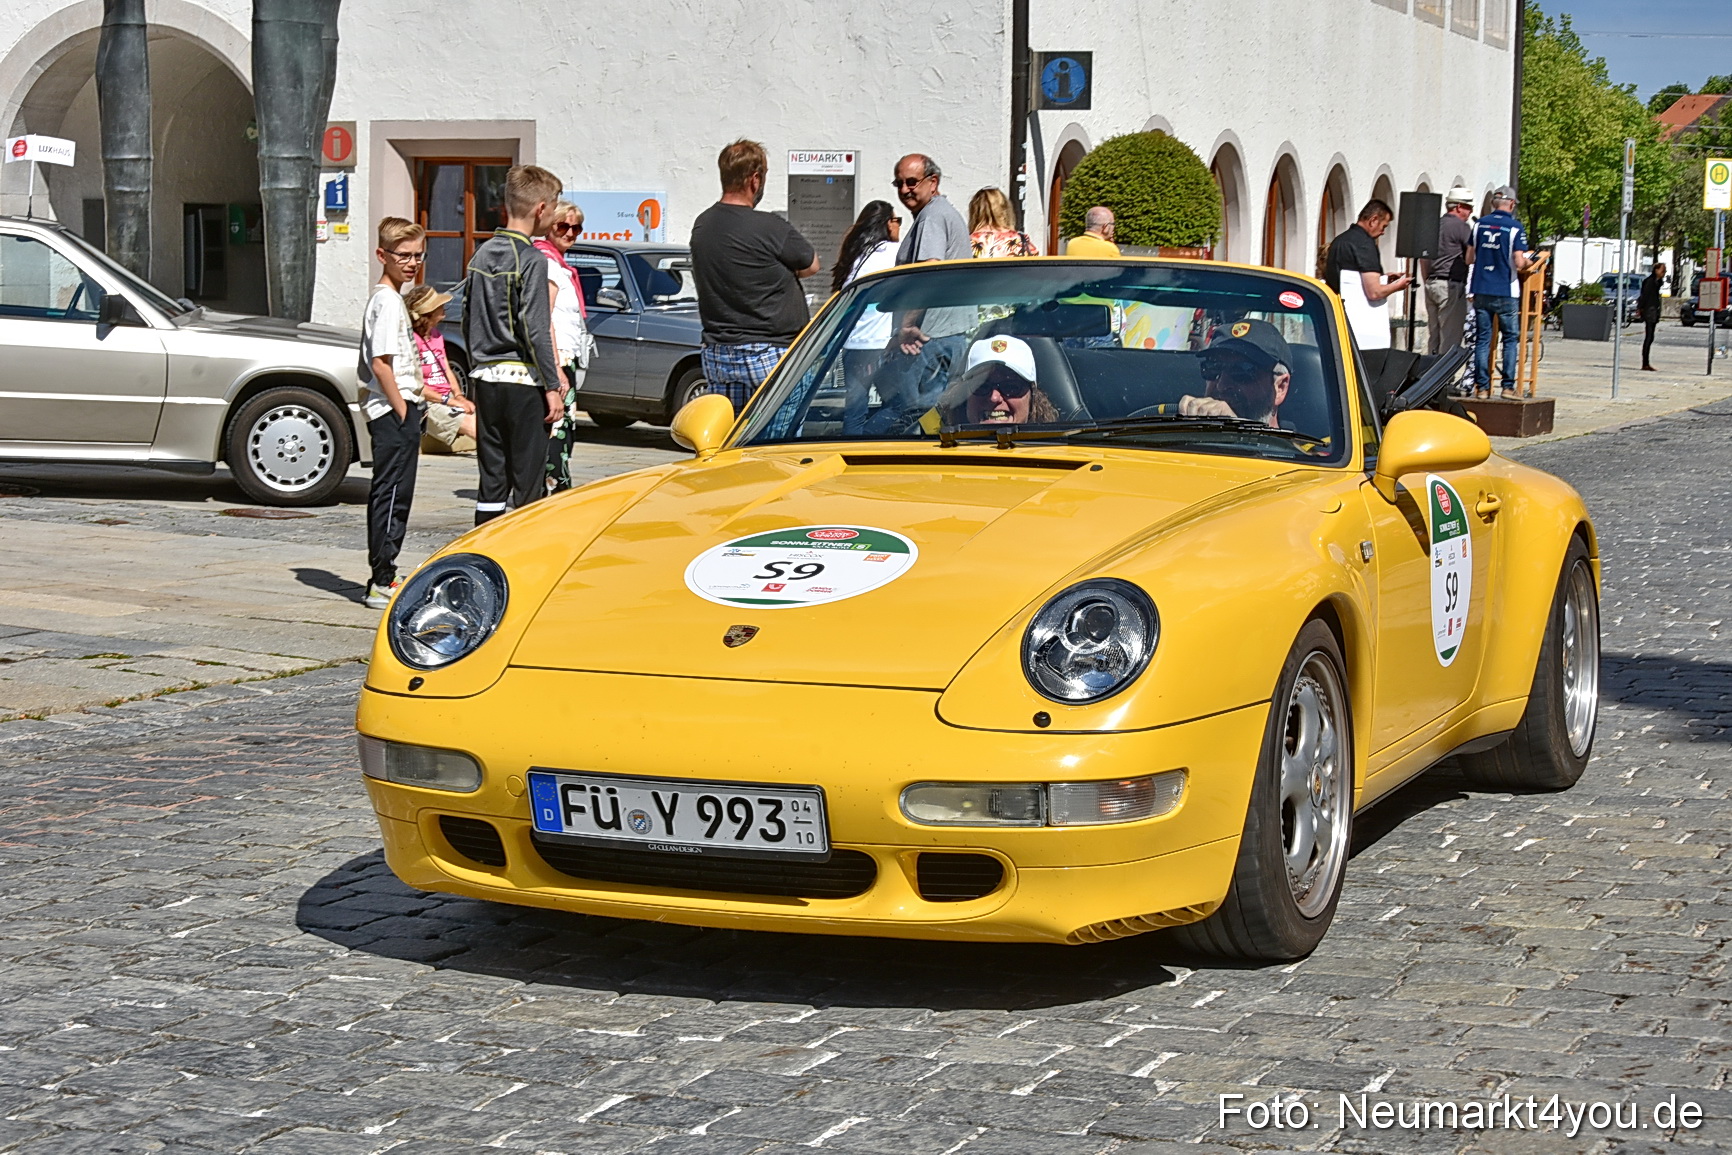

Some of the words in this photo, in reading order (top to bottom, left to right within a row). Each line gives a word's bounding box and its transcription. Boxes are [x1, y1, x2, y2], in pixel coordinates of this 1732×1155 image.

[791, 153, 844, 163] NEUMARKT
[753, 561, 825, 580] S9
[1445, 571, 1459, 613] S9
[561, 783, 622, 831] FÜ
[651, 790, 679, 835] Y
[697, 794, 787, 842] 993
[791, 800, 811, 813] 04
[543, 808, 554, 821] D
[796, 831, 815, 844] 10
